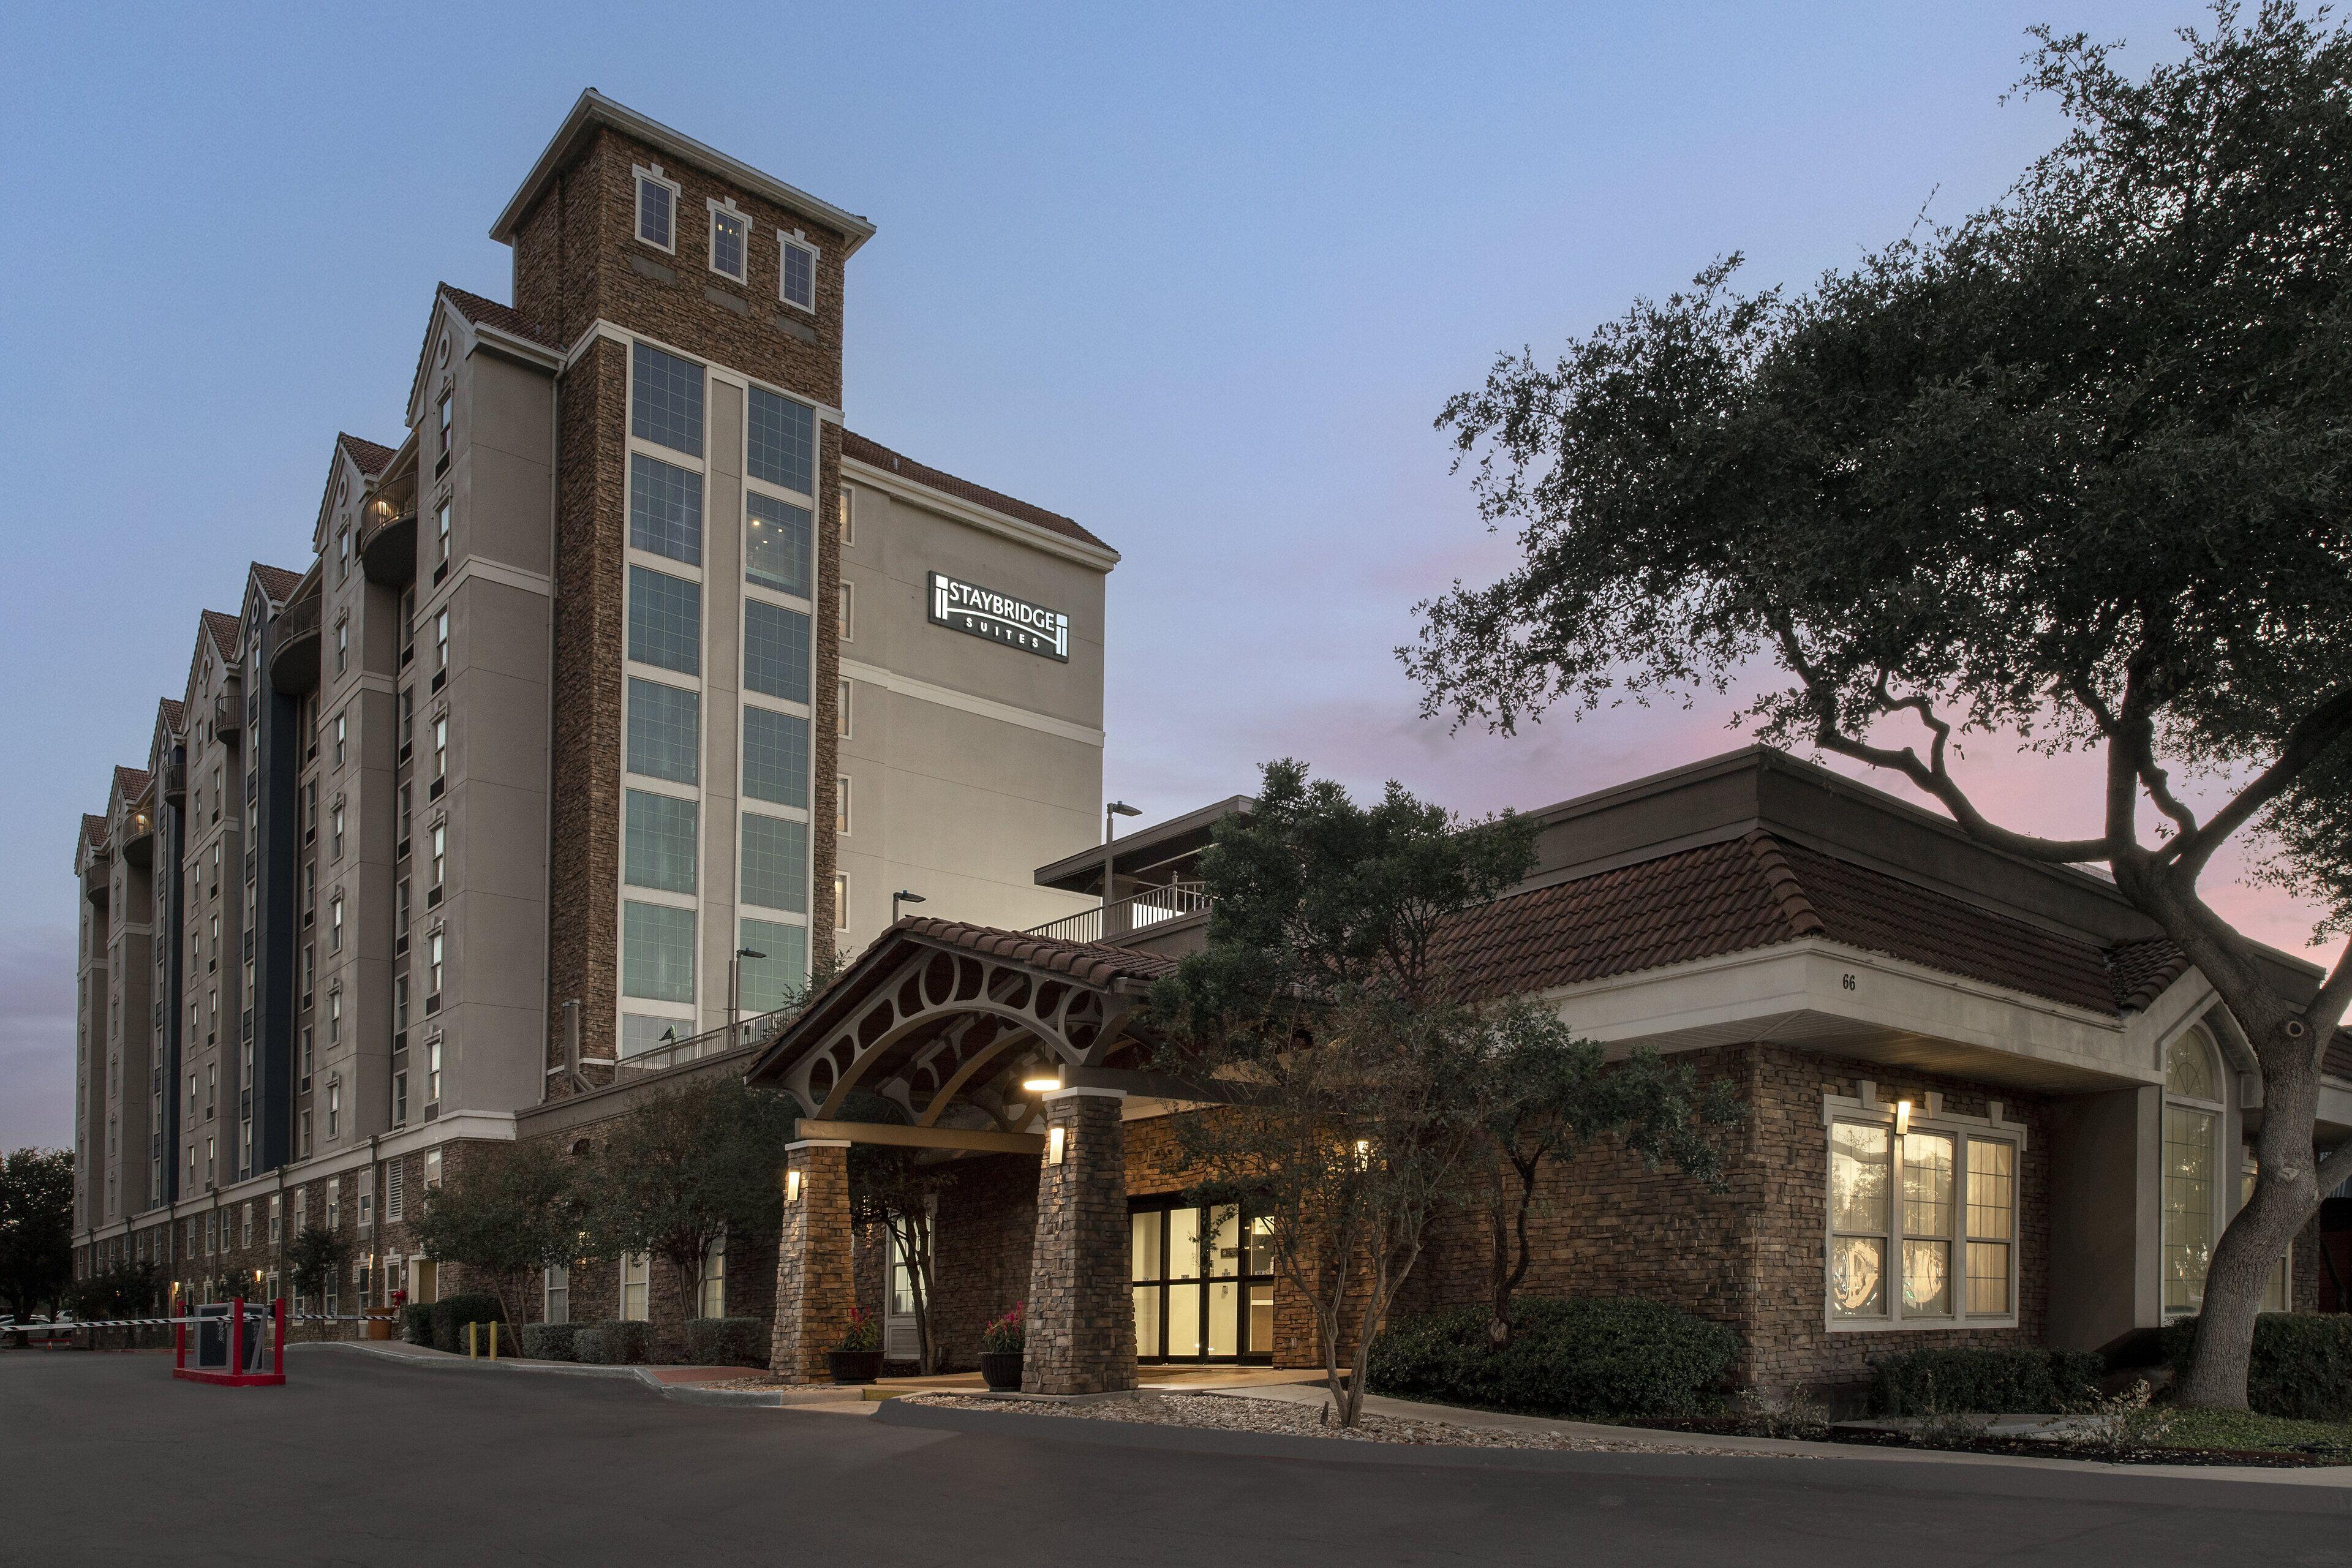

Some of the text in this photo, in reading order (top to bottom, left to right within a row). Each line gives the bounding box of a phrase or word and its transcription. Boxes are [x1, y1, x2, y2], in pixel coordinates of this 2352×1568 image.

[949, 582, 1055, 631] STAYBRIDGE
[966, 617, 1038, 647] SUITES
[1843, 974, 1855, 990] 66
